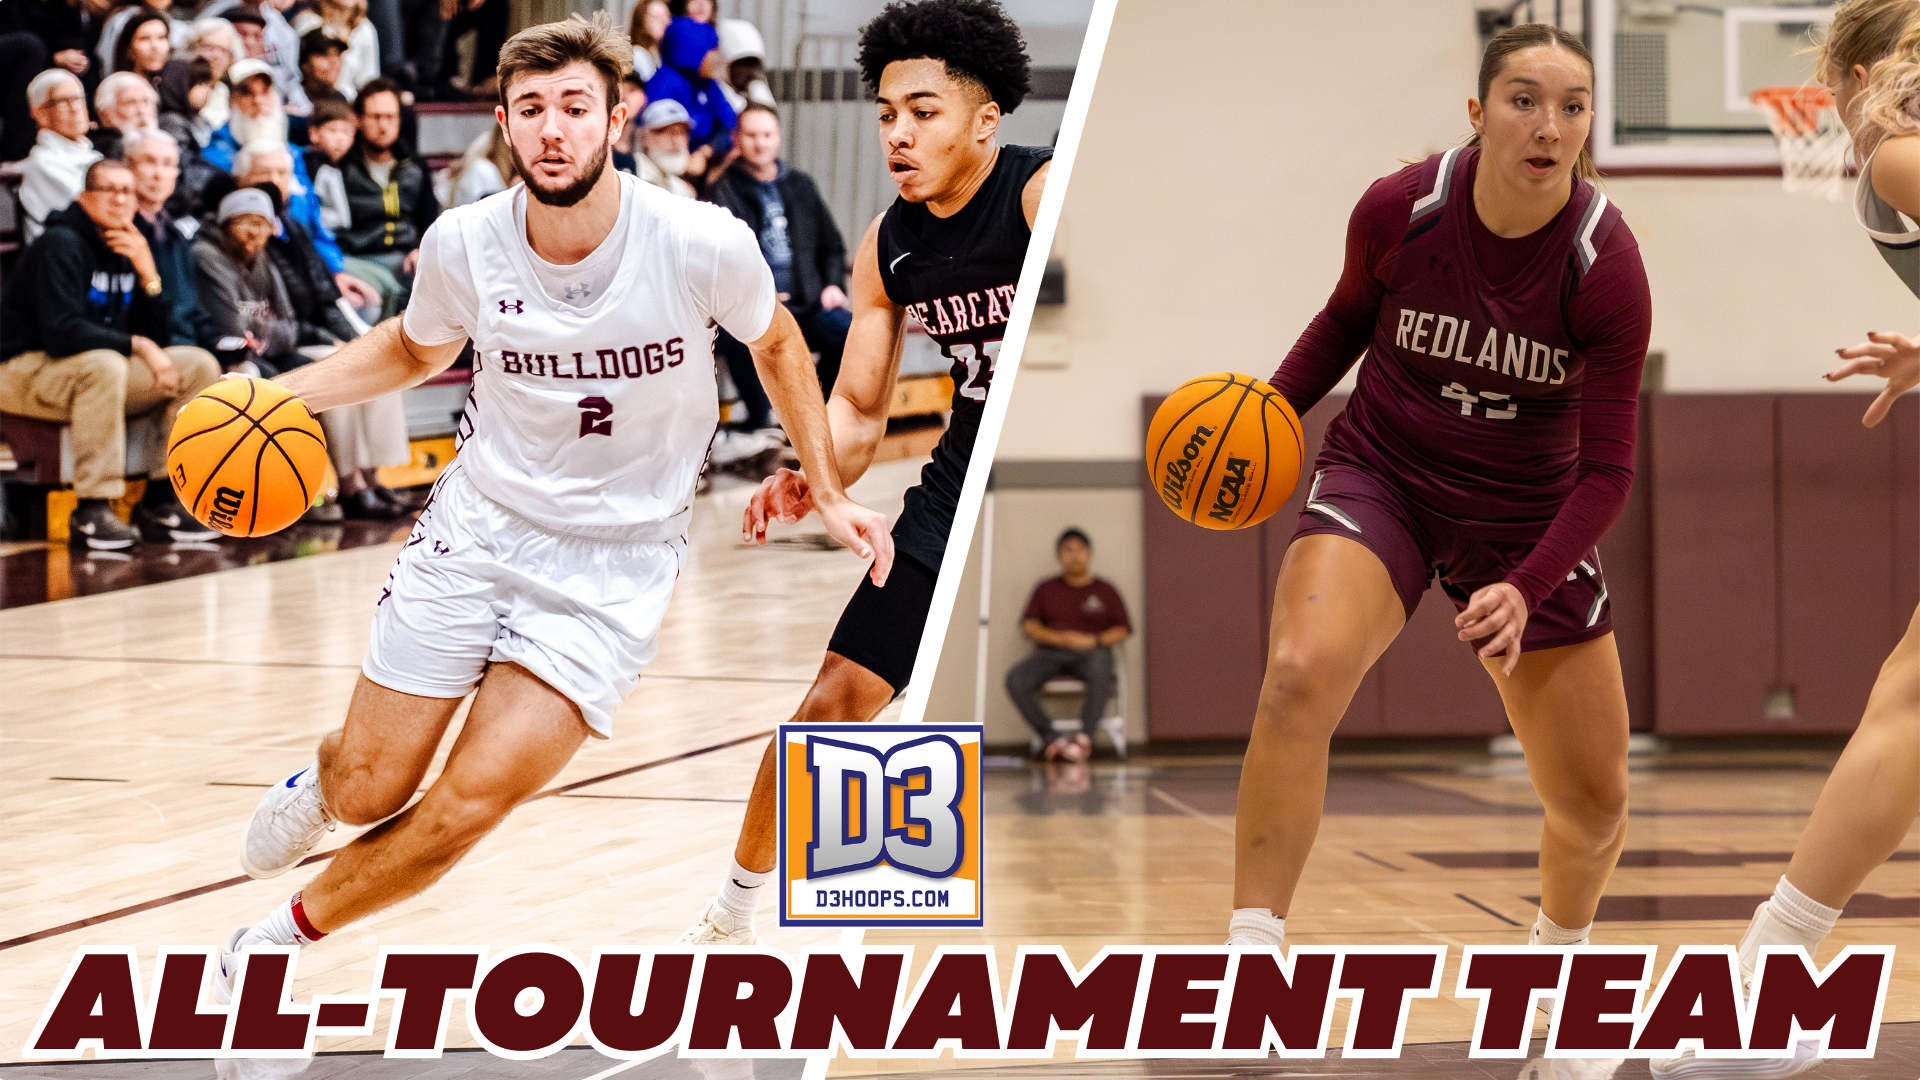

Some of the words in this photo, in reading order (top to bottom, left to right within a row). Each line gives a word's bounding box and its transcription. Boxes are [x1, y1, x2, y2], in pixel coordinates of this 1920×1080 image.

[501, 337, 684, 379] BULLDOGS
[1396, 308, 1569, 385] REDLANDS
[577, 395, 613, 438] 2
[1163, 424, 1216, 511] Wilson
[1208, 457, 1251, 523] NCAA
